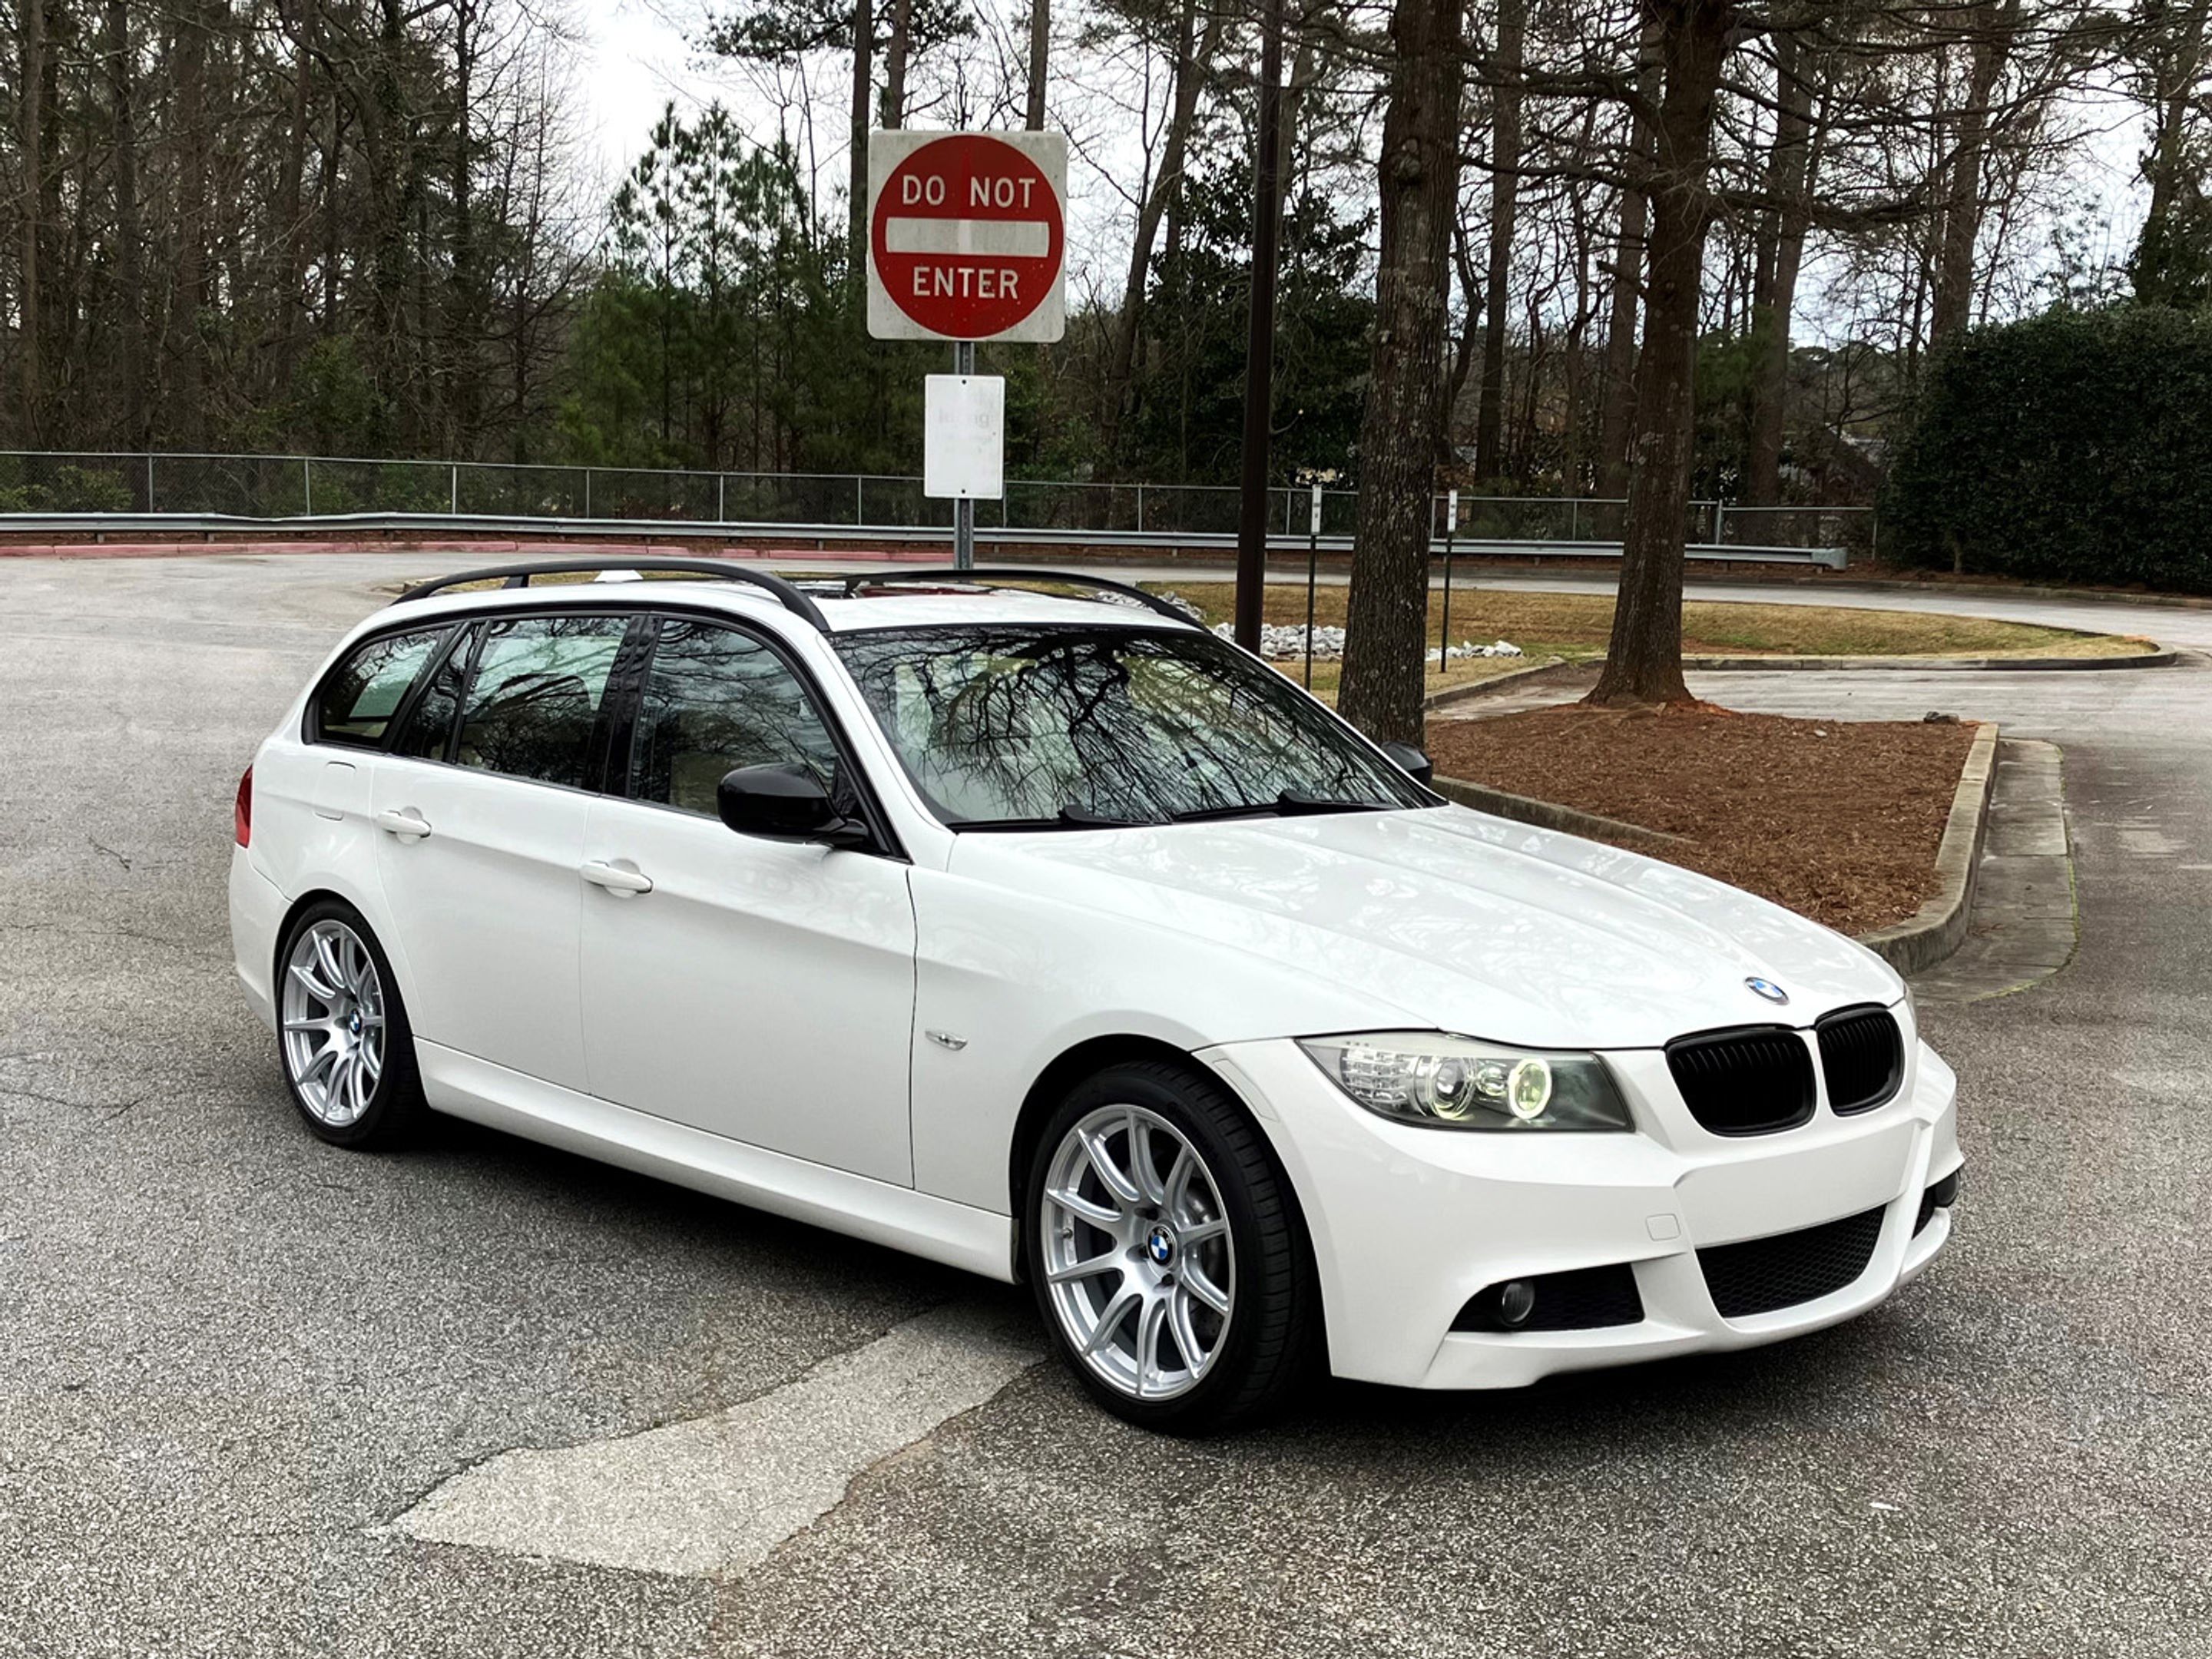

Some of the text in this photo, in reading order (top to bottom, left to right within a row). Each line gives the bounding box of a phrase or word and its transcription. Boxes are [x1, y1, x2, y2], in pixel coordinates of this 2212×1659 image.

[902, 175, 1036, 208] DO NOT
[913, 267, 1019, 299] ENTER
